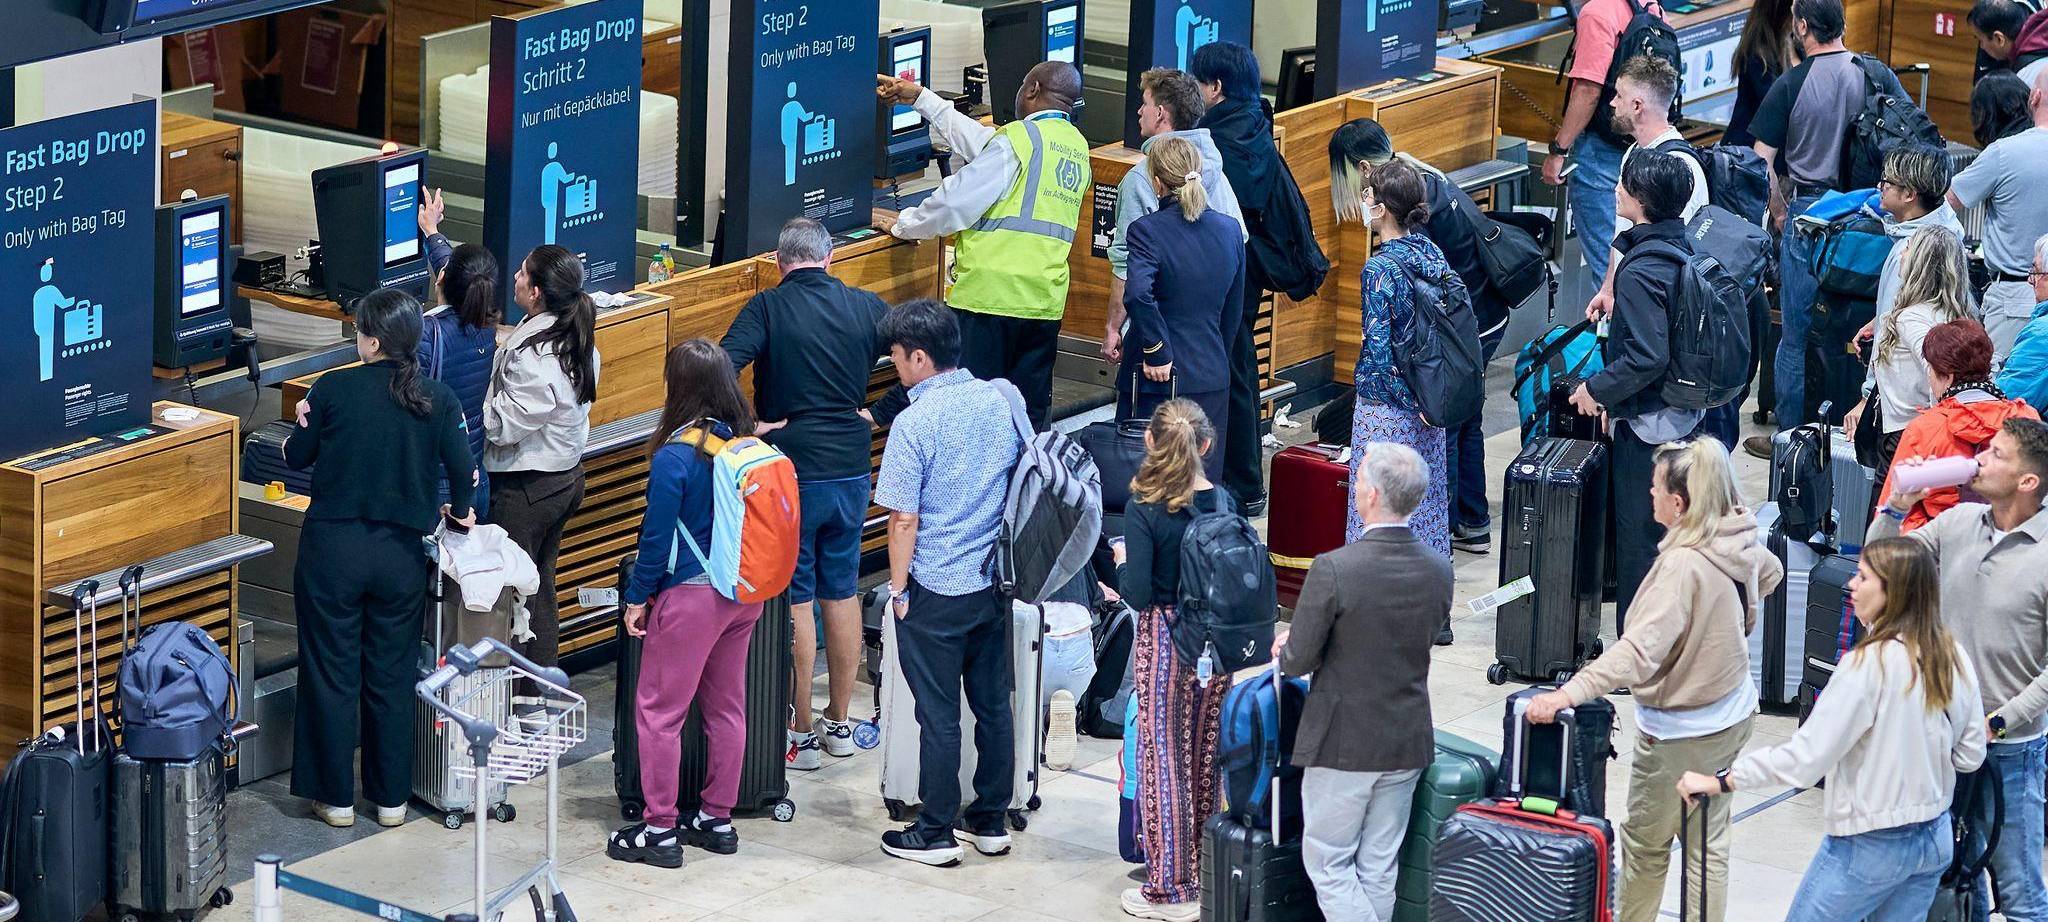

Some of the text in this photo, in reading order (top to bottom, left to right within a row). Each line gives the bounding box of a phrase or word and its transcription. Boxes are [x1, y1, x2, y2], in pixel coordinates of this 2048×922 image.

[762, 5, 808, 35] Step 2
[524, 17, 635, 60] Fast Bag Drop
[761, 35, 855, 68] Only with Bag Tag
[523, 58, 586, 94] Schritt 2
[521, 85, 631, 129] Nur mit Gepäcklabel
[6, 128, 146, 175] Fast Bag Drop
[1049, 141, 1072, 159] Mobility
[5, 176, 64, 212] Step 2
[5, 209, 126, 249] Only with Bag Tag
